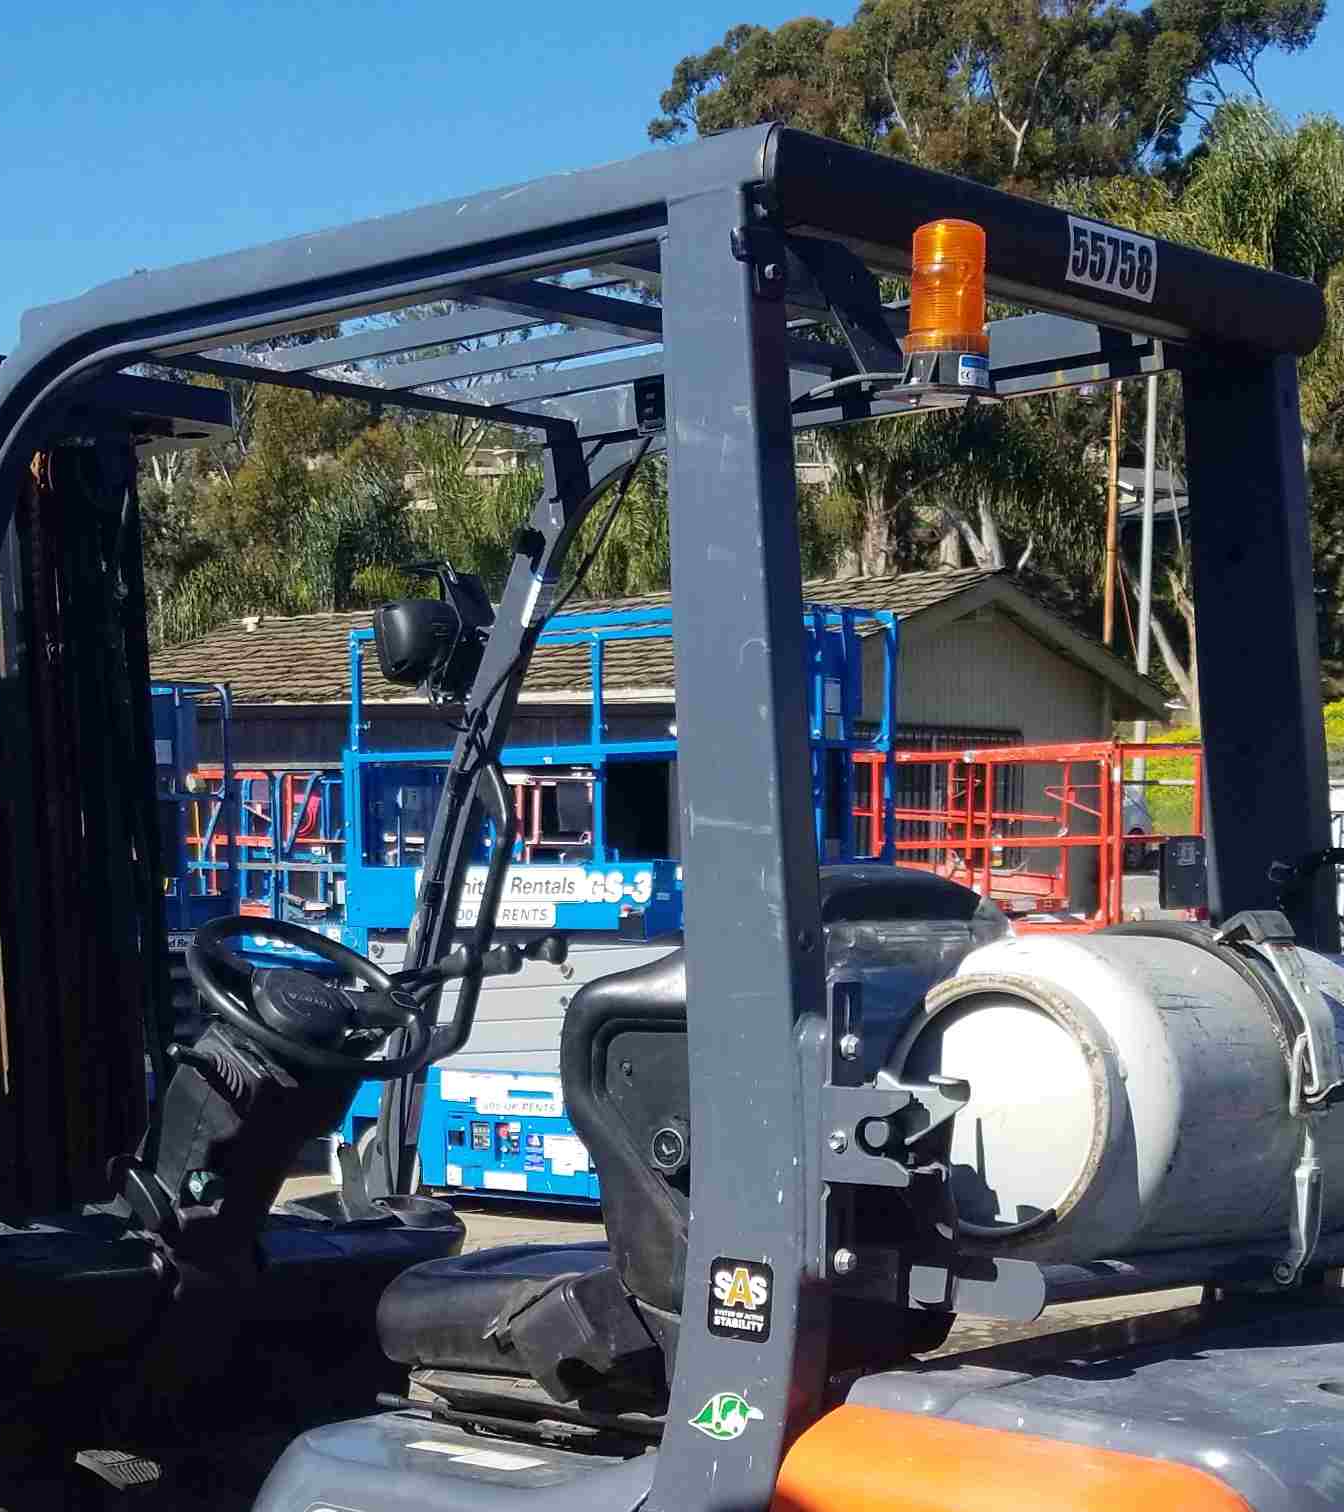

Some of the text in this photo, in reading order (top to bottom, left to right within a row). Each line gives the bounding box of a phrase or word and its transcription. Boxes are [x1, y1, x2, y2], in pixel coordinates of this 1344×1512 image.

[1071, 226, 1154, 295] 55758
[511, 876, 576, 896] Rentals
[713, 1267, 767, 1309] SAS
[713, 1315, 764, 1332] STABILITY
